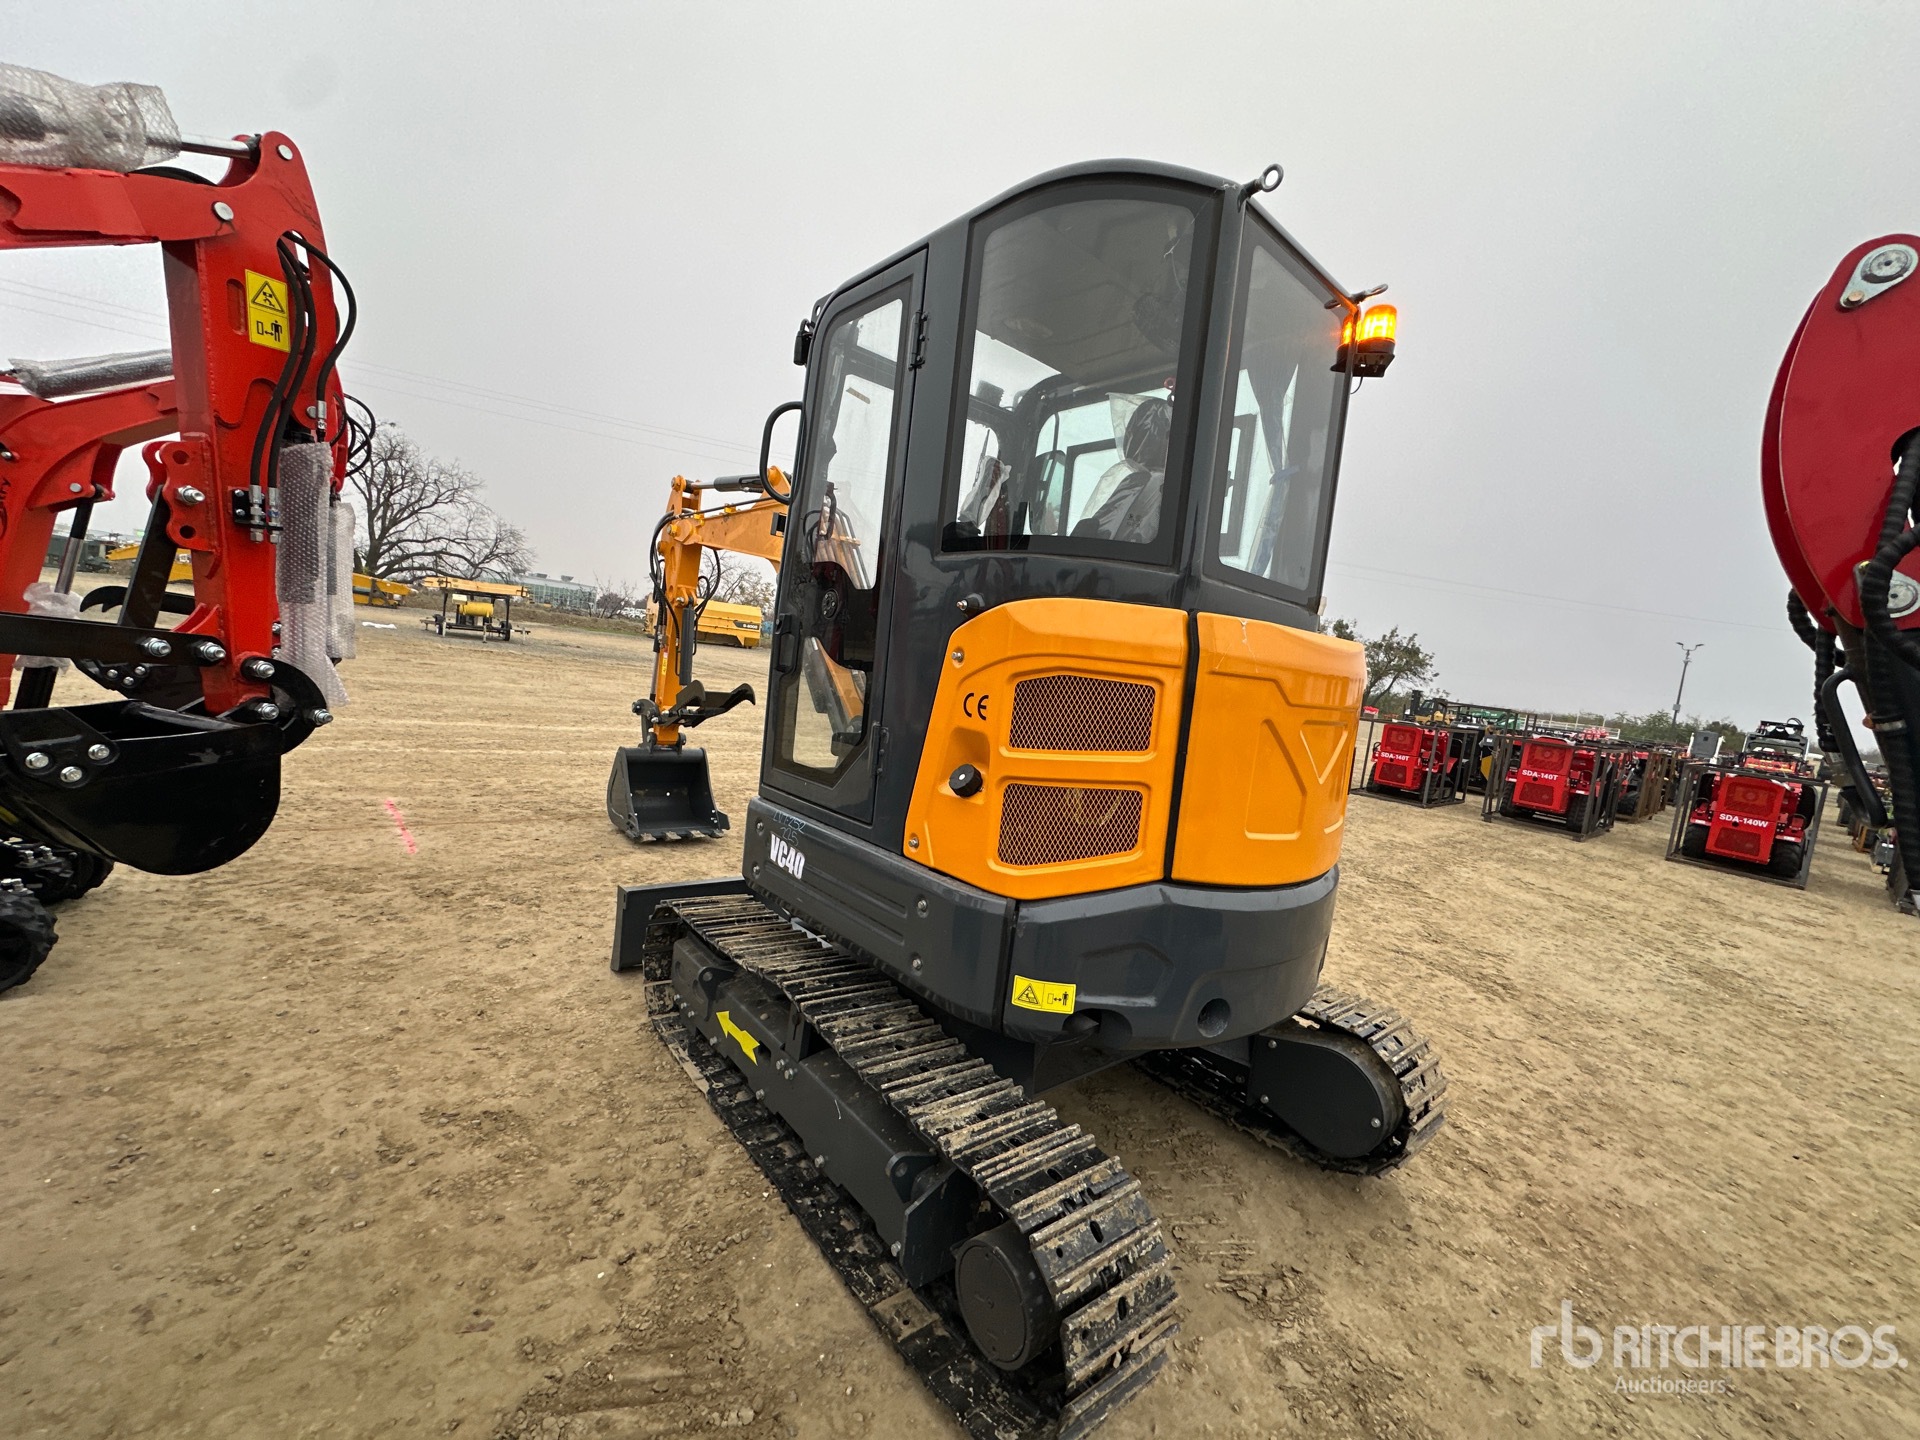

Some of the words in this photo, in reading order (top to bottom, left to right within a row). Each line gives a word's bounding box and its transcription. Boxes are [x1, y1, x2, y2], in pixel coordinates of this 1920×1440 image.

[963, 692, 989, 721] CE
[1380, 751, 1410, 762] SDA-140T
[1521, 769, 1559, 781] SDA-140T
[1719, 813, 1769, 828] SDA-140W
[770, 833, 806, 880] VC40
